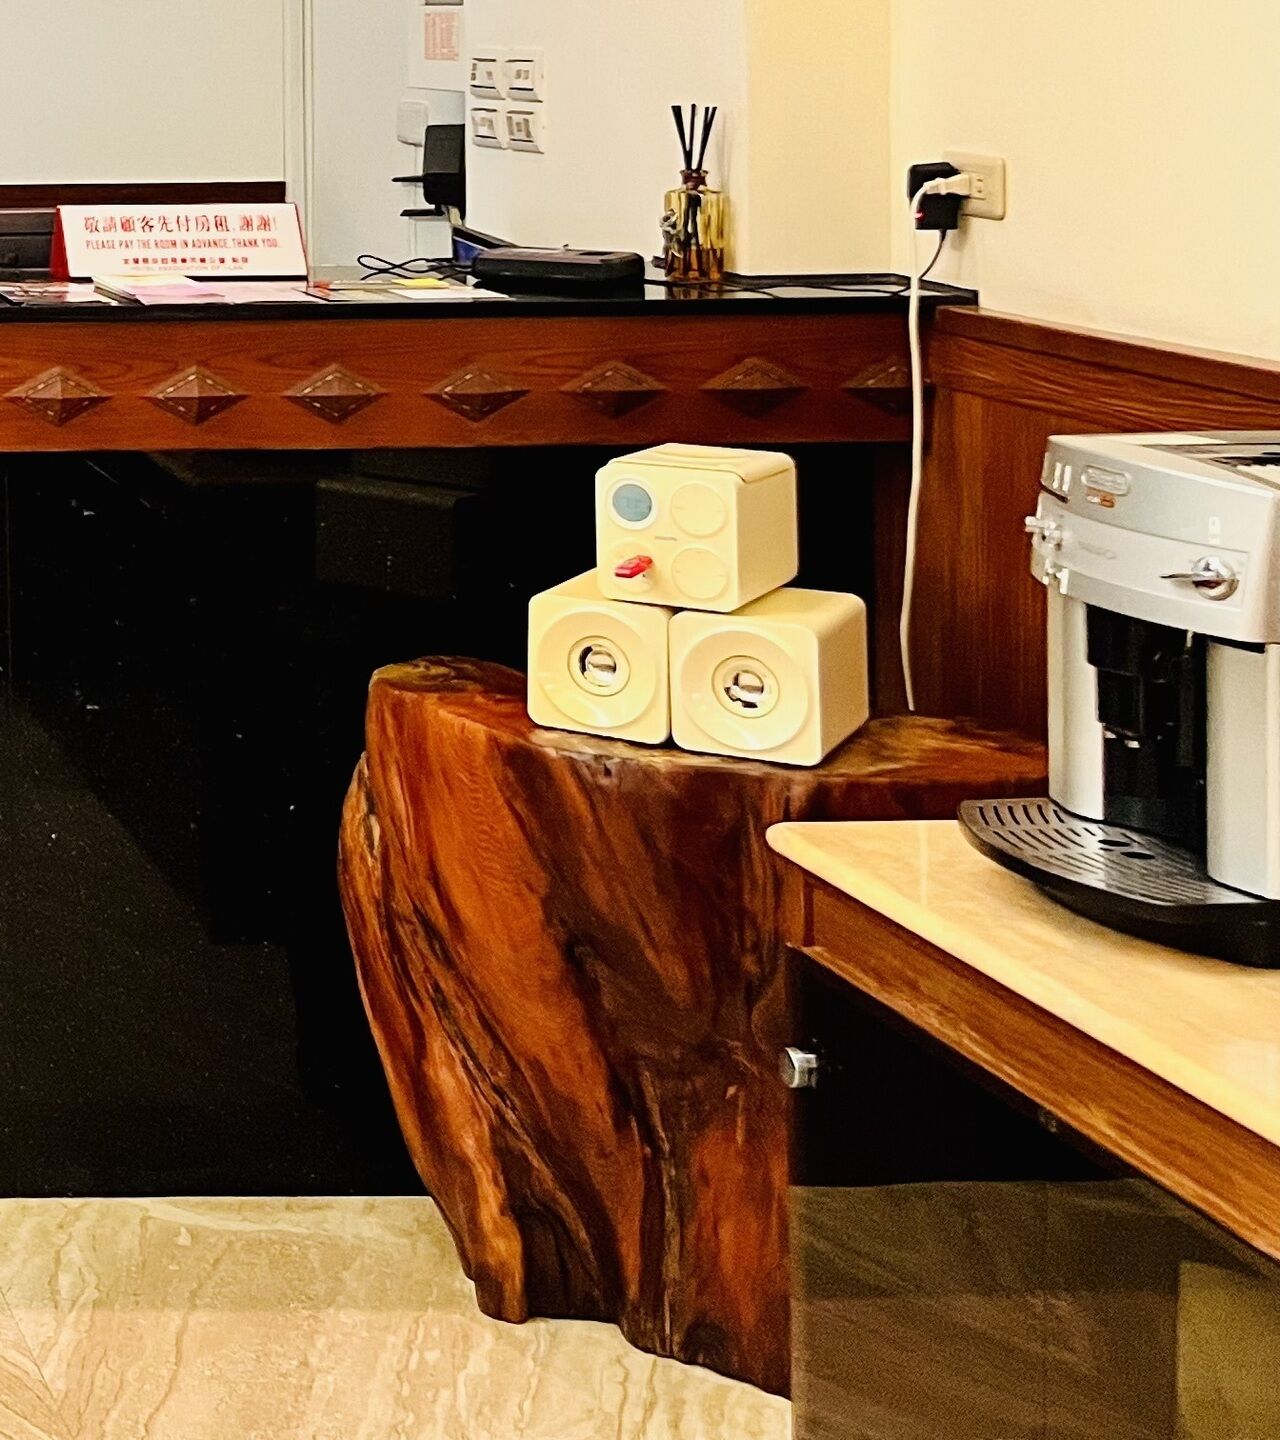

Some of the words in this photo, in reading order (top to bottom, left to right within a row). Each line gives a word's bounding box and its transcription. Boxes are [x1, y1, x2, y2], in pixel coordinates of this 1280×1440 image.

[86, 239, 116, 249] PLEASE
[119, 239, 134, 249] PAY
[137, 239, 151, 249] THE
[154, 239, 178, 249] ROOM
[232, 238, 259, 249] THANK
